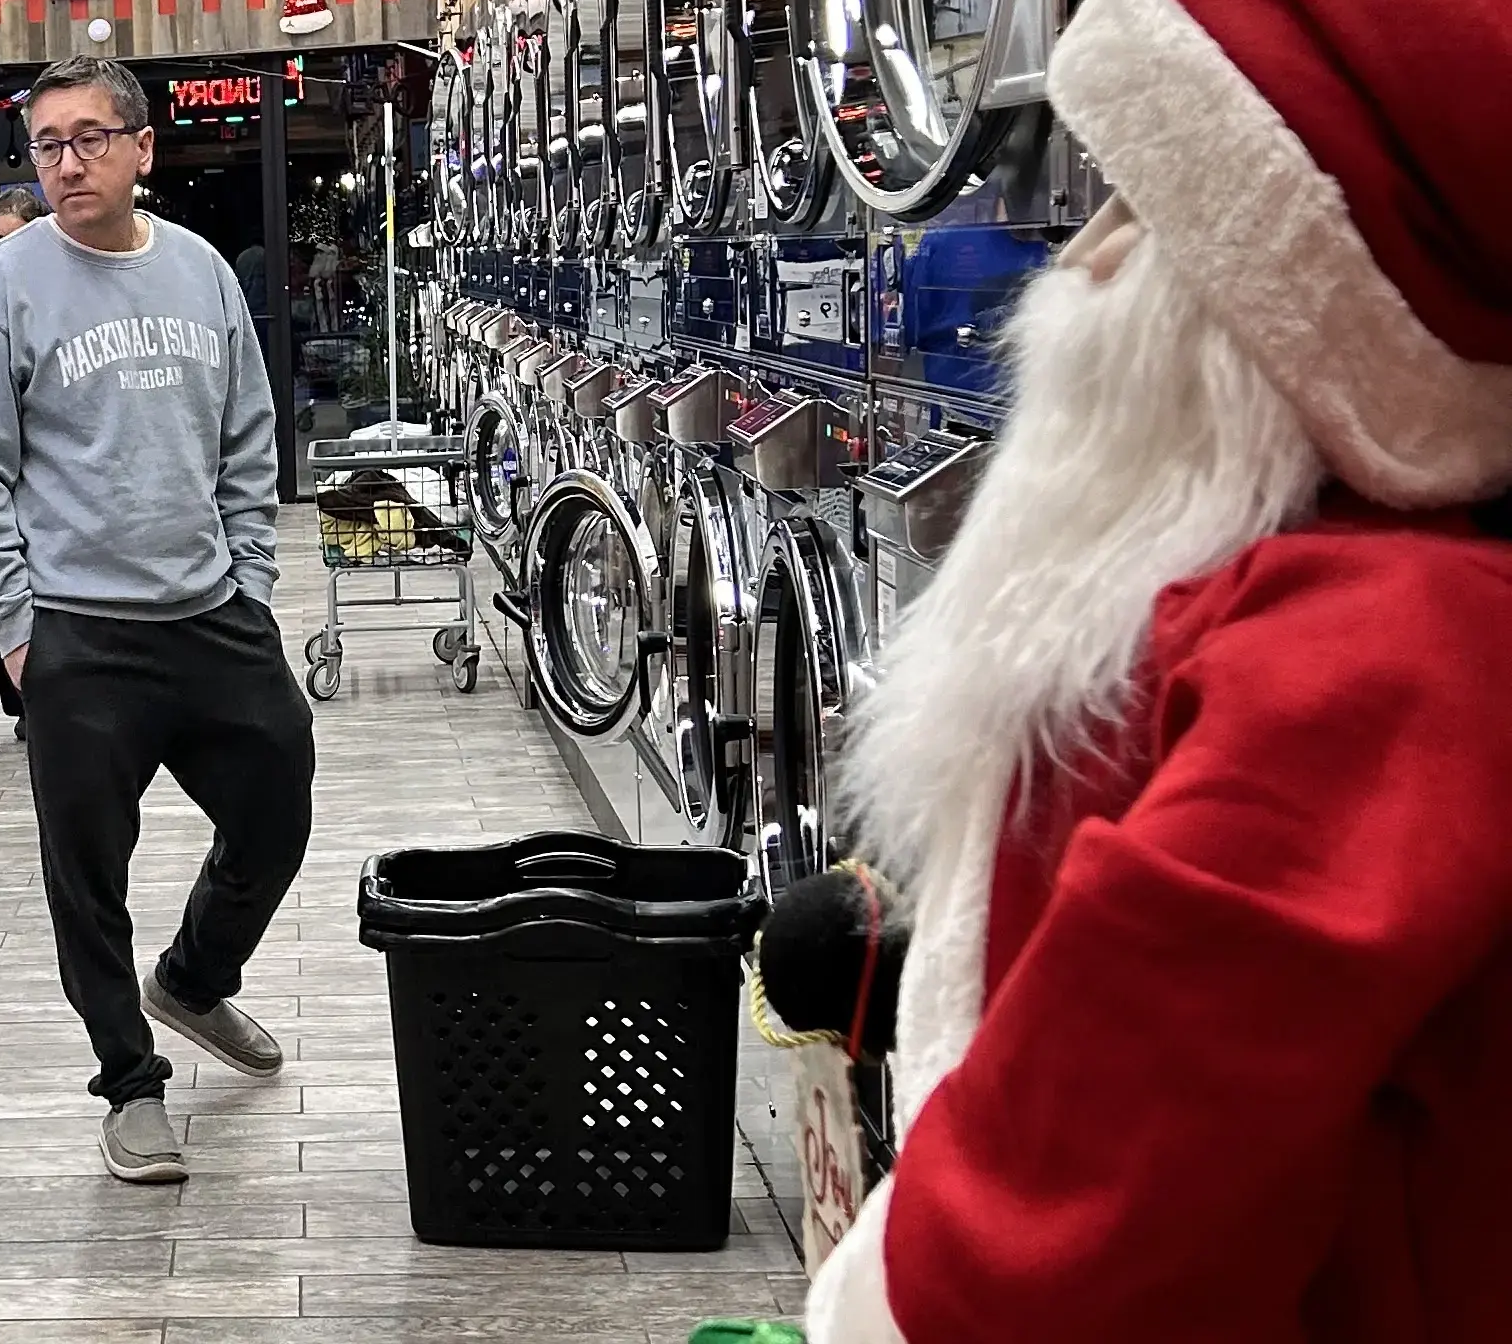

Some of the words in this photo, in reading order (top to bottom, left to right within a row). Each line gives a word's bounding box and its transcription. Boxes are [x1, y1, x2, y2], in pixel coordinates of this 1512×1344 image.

[56, 317, 157, 388] MACKINAC
[157, 317, 220, 369] ISLAND
[118, 366, 184, 391] MICHIGAN
